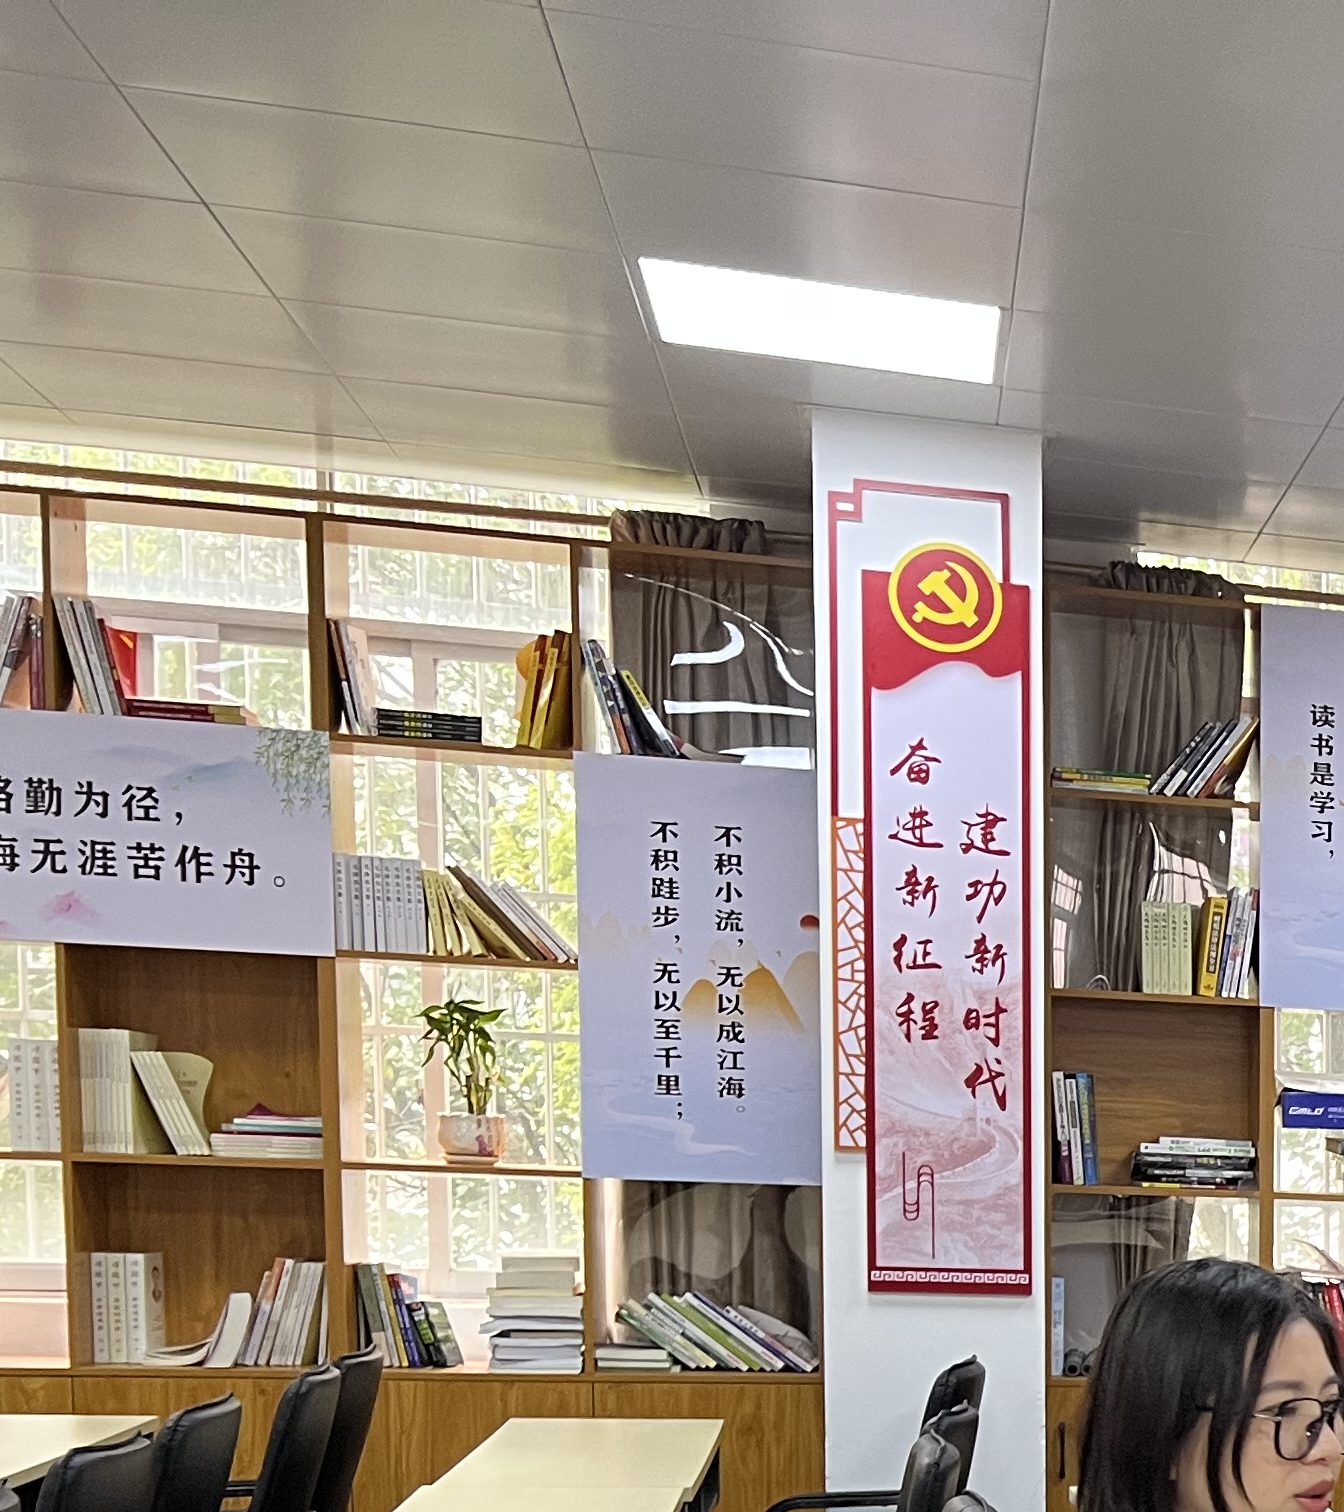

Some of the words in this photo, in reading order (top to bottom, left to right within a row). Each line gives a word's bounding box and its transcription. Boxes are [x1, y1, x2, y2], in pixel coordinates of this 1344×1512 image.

[889, 737, 943, 1046] 奋进新征程
[1309, 704, 1335, 859] 读书是学习，
[650, 821, 682, 1121] 不积跬步，无以至千里；
[714, 825, 746, 1113] 不积小流，无以成江海。
[959, 802, 1012, 1113] 建功新时代
